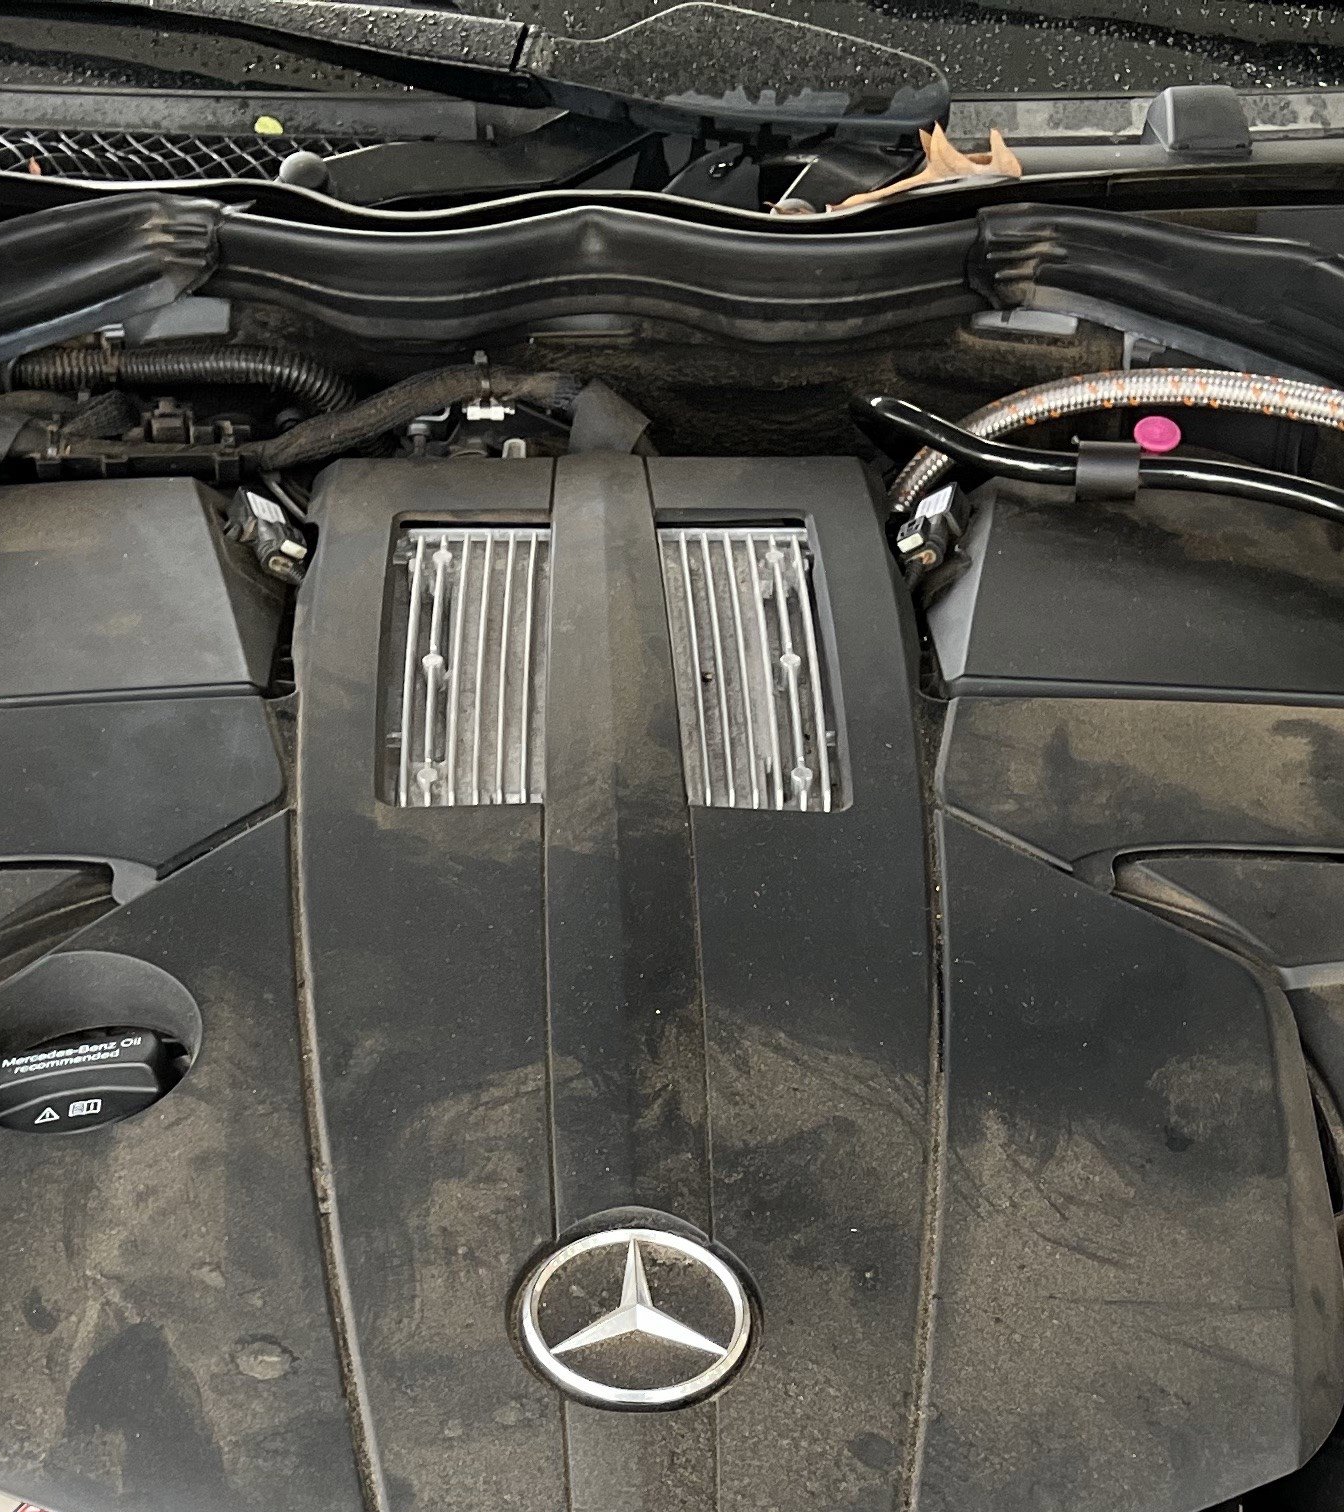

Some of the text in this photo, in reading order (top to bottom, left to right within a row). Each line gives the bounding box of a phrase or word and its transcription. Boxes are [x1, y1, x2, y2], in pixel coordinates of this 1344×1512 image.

[2, 1036, 142, 1068] Mercedes-Benz Oil
[14, 1050, 120, 1074] recommended
